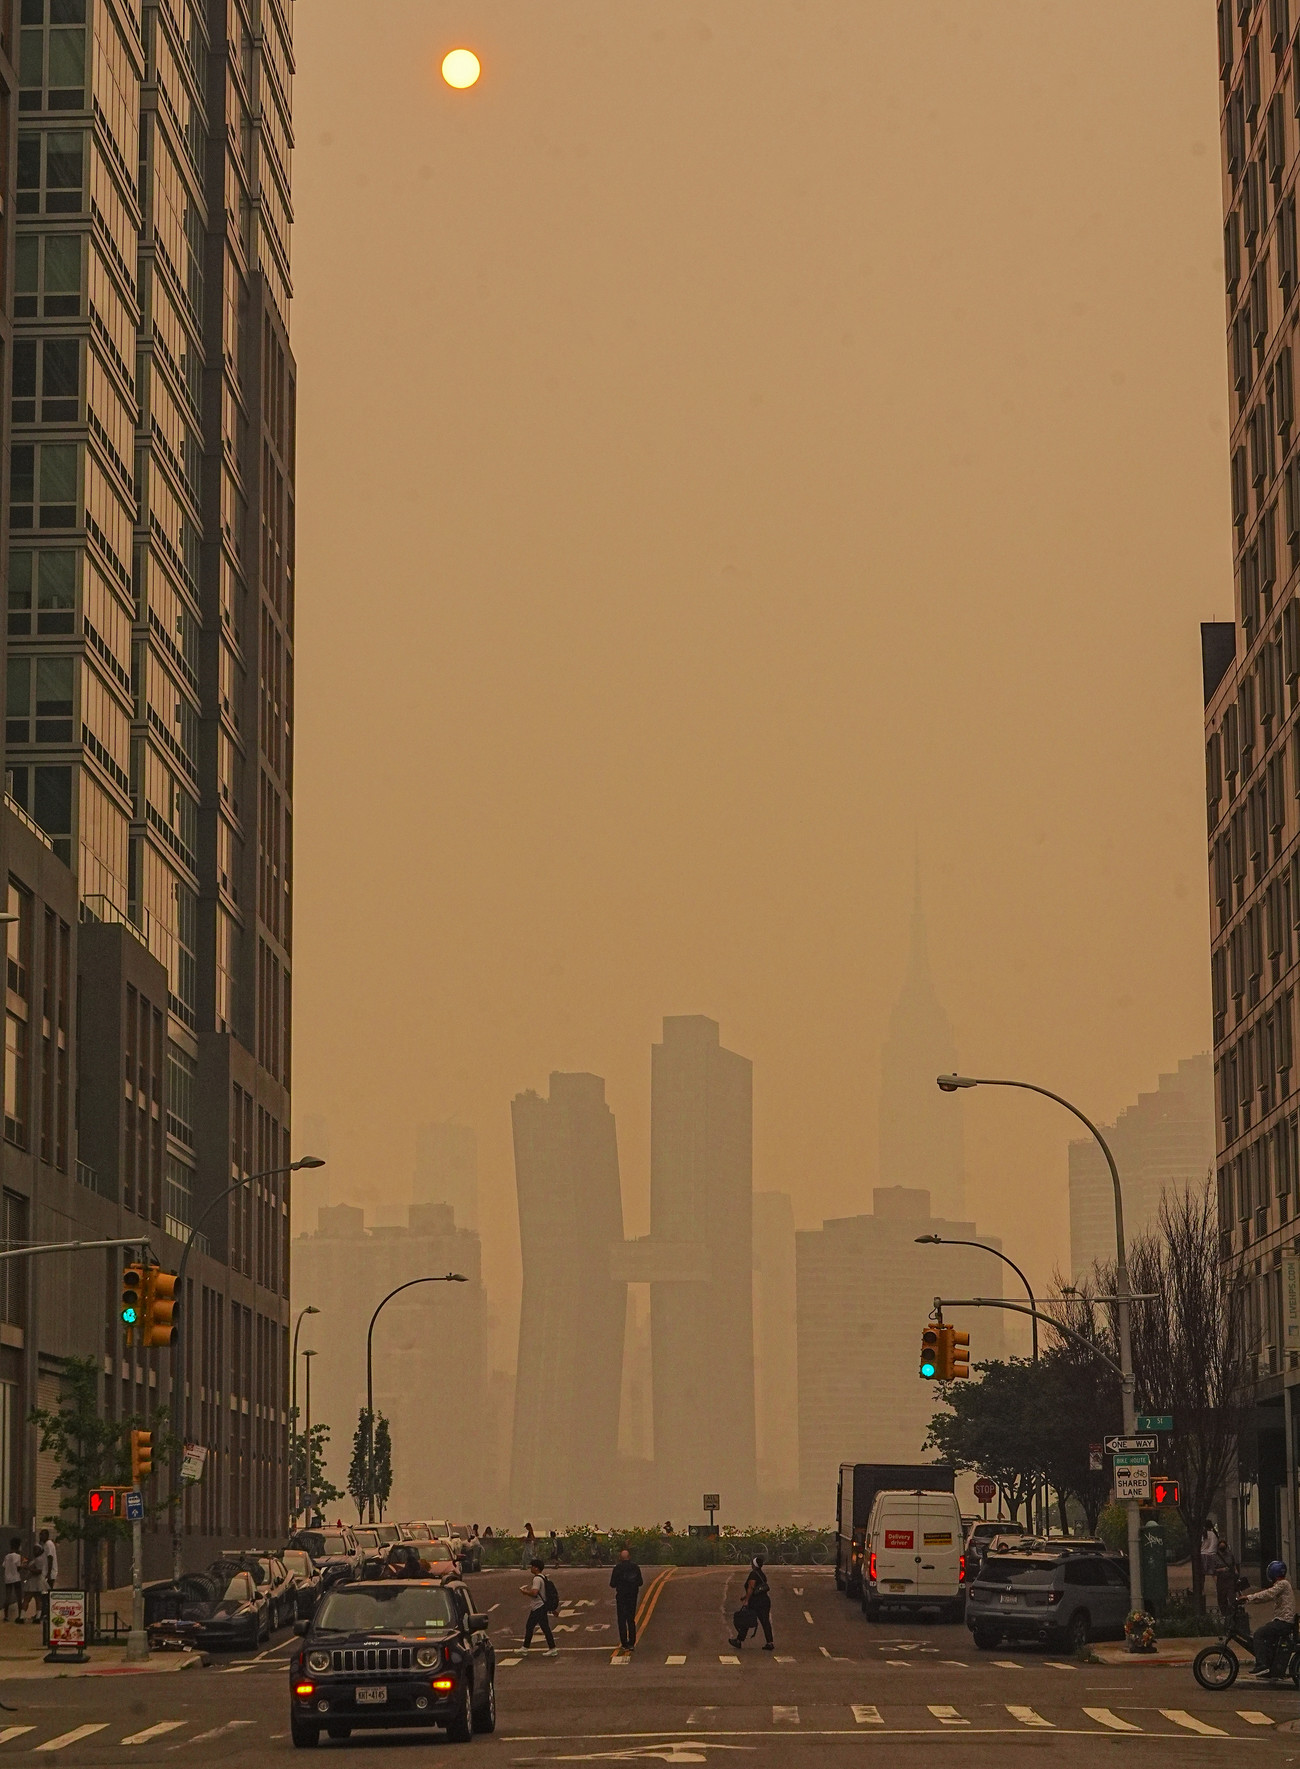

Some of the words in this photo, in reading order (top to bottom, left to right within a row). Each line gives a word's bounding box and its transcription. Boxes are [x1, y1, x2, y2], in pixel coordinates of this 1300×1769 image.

[1145, 1418, 1151, 1429] 2
[1135, 1440, 1153, 1448] WAY
[1117, 1479, 1148, 1487] SHARED
[975, 1484, 995, 1494] STOP
[1123, 1488, 1143, 1496] LANE
[888, 1533, 911, 1541] Delivery
